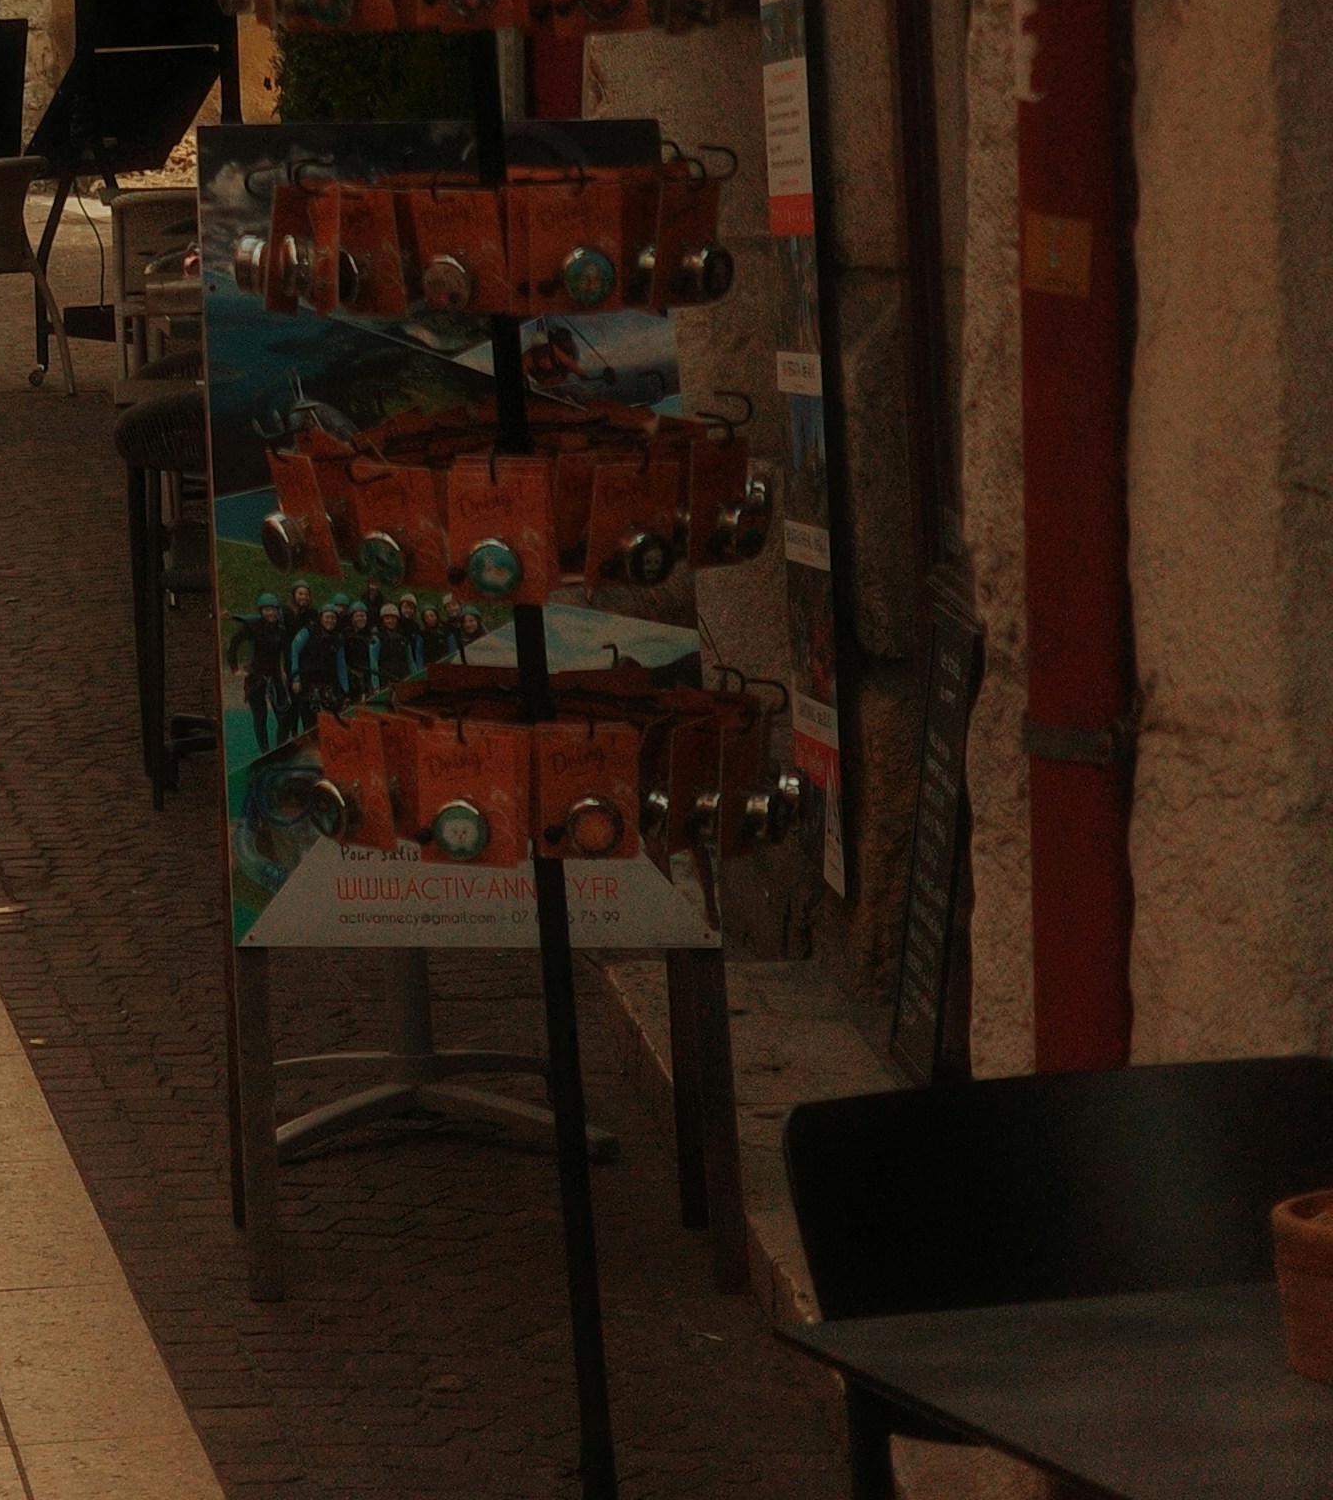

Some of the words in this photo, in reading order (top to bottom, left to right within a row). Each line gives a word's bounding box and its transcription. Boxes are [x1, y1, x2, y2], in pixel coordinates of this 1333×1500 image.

[339, 845, 372, 863] Pour
[380, 842, 419, 862] satis
[336, 876, 620, 902] WWW.ACTIV-ANNY.FR
[338, 909, 497, 928] activannecy@gmail.com
